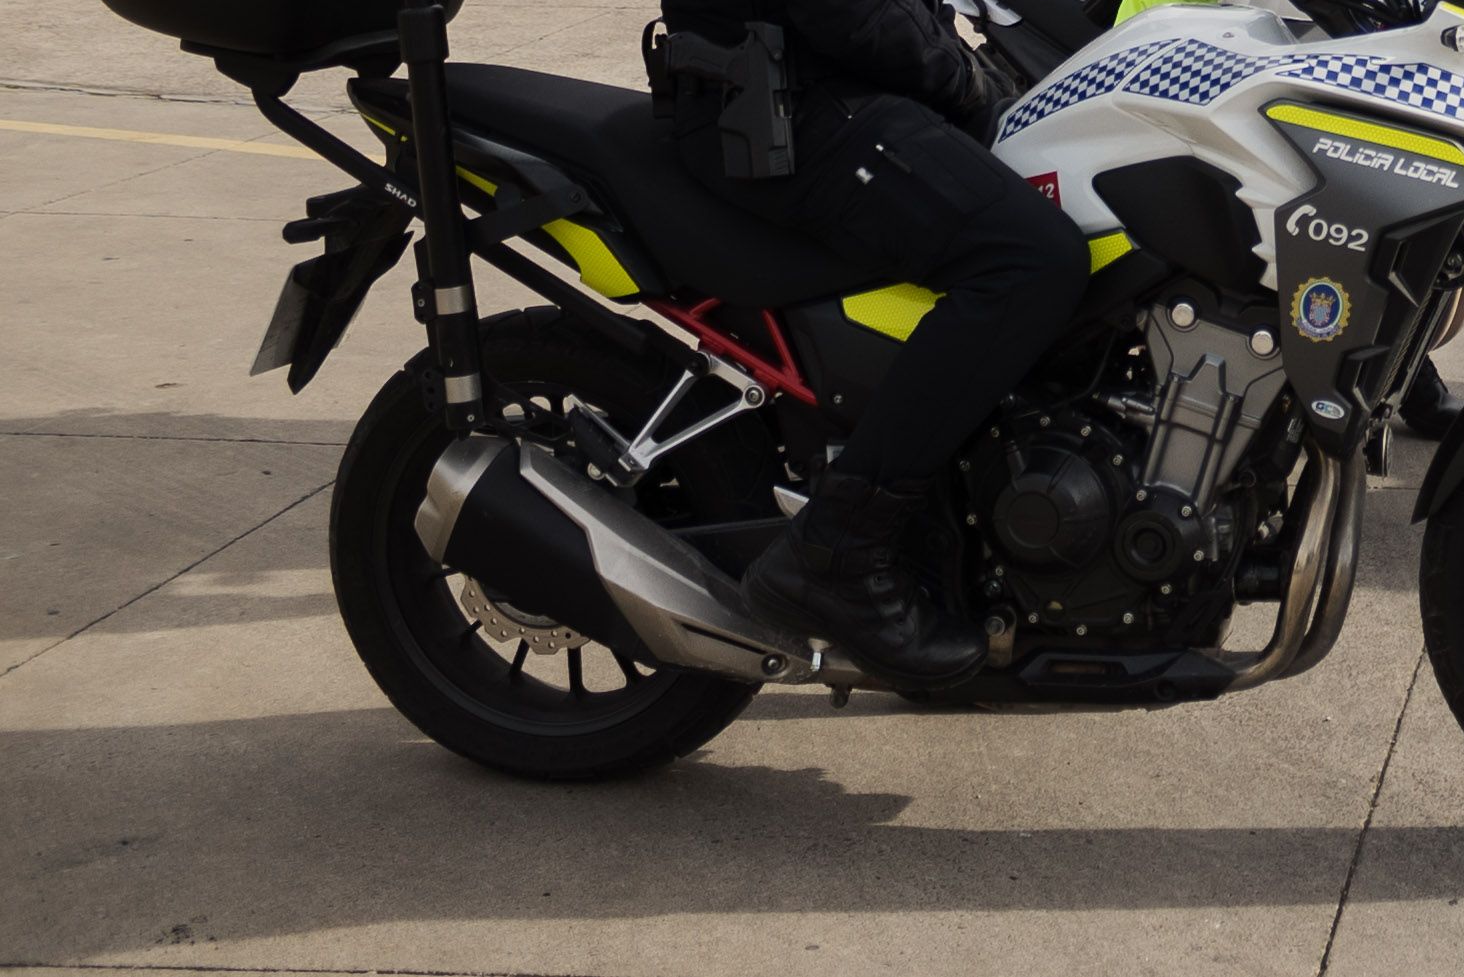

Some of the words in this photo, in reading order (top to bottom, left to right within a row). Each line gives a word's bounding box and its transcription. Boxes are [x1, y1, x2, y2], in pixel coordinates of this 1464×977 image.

[1312, 137, 1395, 171] POLICIA
[1394, 157, 1460, 188] LOCAL
[384, 182, 417, 208] SHAD
[1308, 219, 1369, 252] 092
